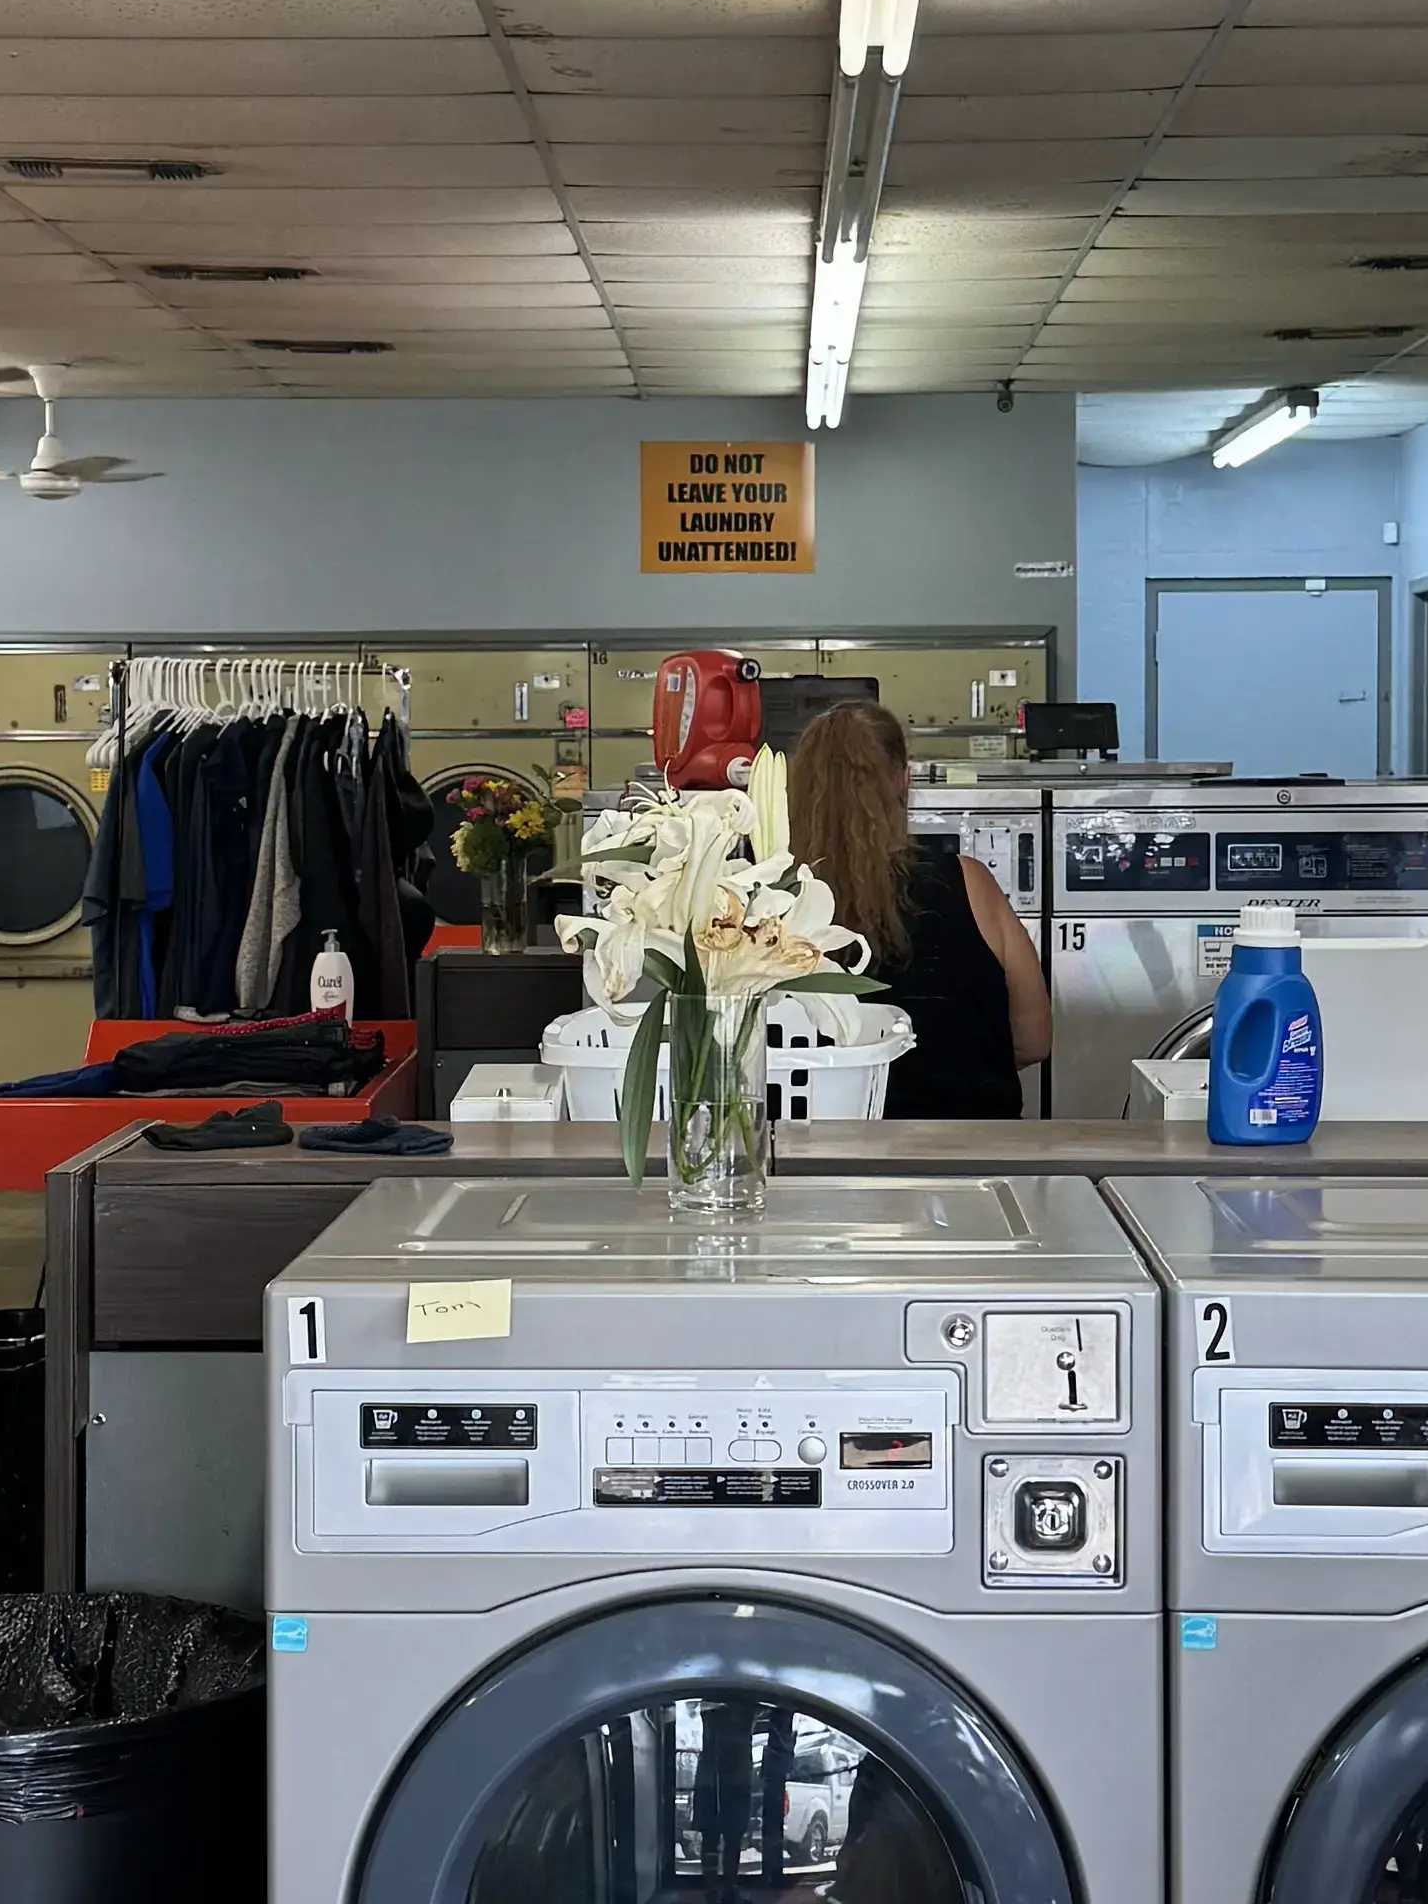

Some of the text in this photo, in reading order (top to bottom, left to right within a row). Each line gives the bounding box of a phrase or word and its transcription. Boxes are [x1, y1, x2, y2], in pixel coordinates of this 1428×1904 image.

[690, 454, 765, 474] DO NOT
[667, 483, 788, 503] LEAVE YOUR
[680, 512, 775, 533] LAUNDRY
[658, 541, 797, 562] UNATTENDED!
[592, 652, 608, 665] 16
[1248, 898, 1321, 908] DEXTER
[1058, 923, 1086, 950] 15
[413, 1299, 482, 1317] Tony
[299, 1301, 318, 1359] 1
[1203, 1302, 1231, 1362] 2
[847, 1479, 915, 1491] CROSSOVER 2.0
